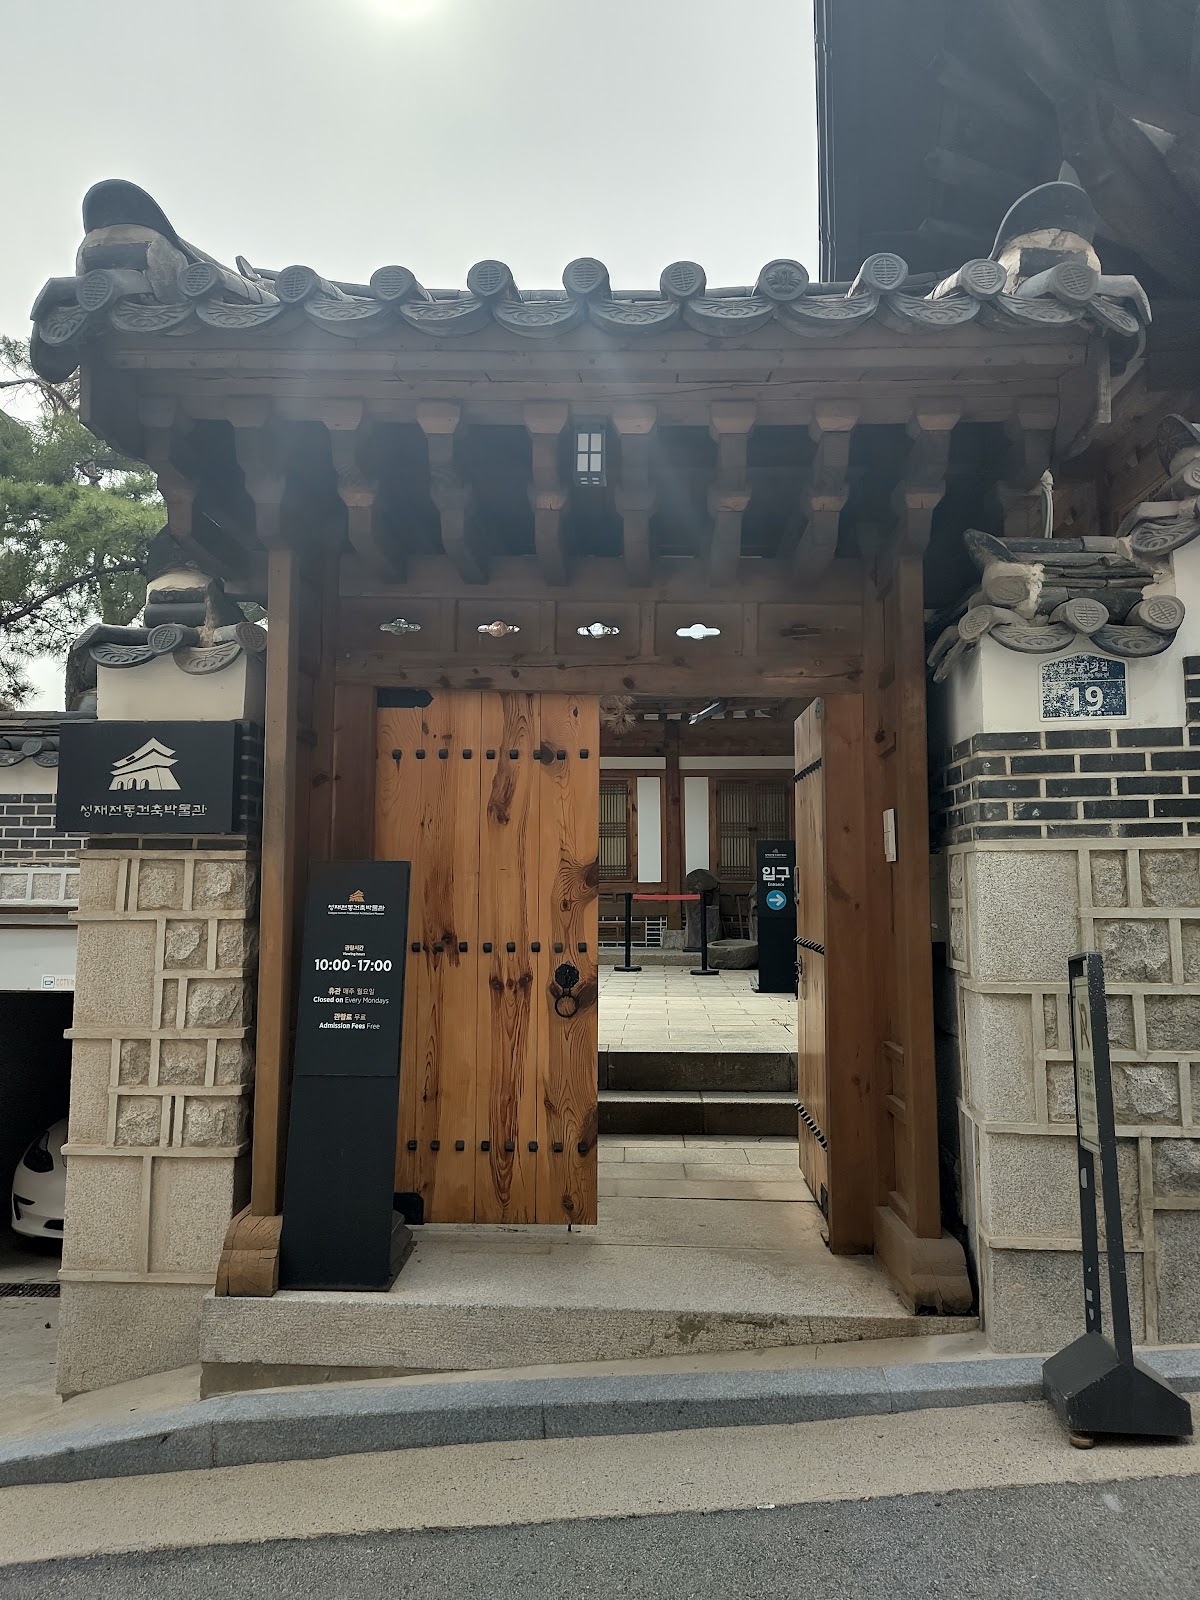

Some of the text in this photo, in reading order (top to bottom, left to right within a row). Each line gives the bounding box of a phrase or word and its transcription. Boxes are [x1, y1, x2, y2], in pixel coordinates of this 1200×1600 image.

[1068, 686, 1103, 711] 19
[80, 804, 207, 817] 성재전통건축박물관
[762, 866, 791, 881] 입구
[328, 987, 341, 995] 휴관
[357, 988, 375, 996] 월요일
[363, 997, 390, 1005] Mondays
[334, 1013, 367, 1021] 관람료 무료
